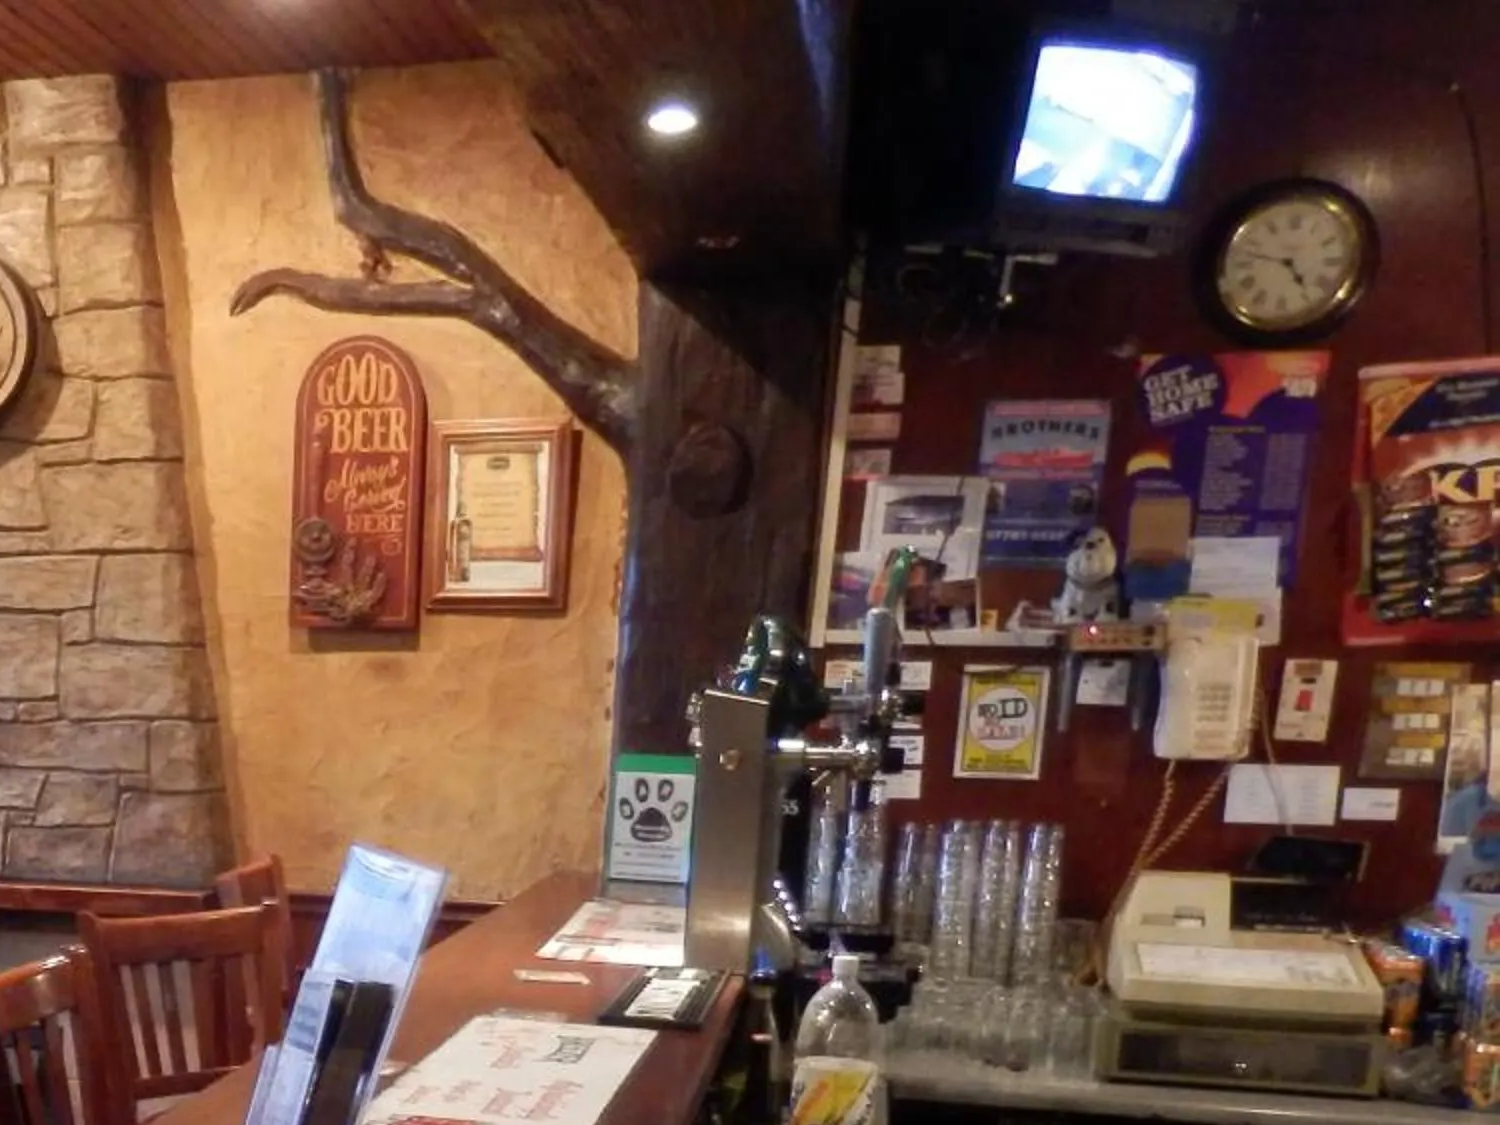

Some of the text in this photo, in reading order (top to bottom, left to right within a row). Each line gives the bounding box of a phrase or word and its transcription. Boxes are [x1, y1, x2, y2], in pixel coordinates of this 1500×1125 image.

[317, 352, 398, 405] GOOD
[1144, 365, 1193, 392] GET
[1146, 373, 1218, 406] HOME
[1150, 391, 1214, 423] SAFE
[315, 406, 408, 454] BEER
[346, 513, 405, 533] HERE
